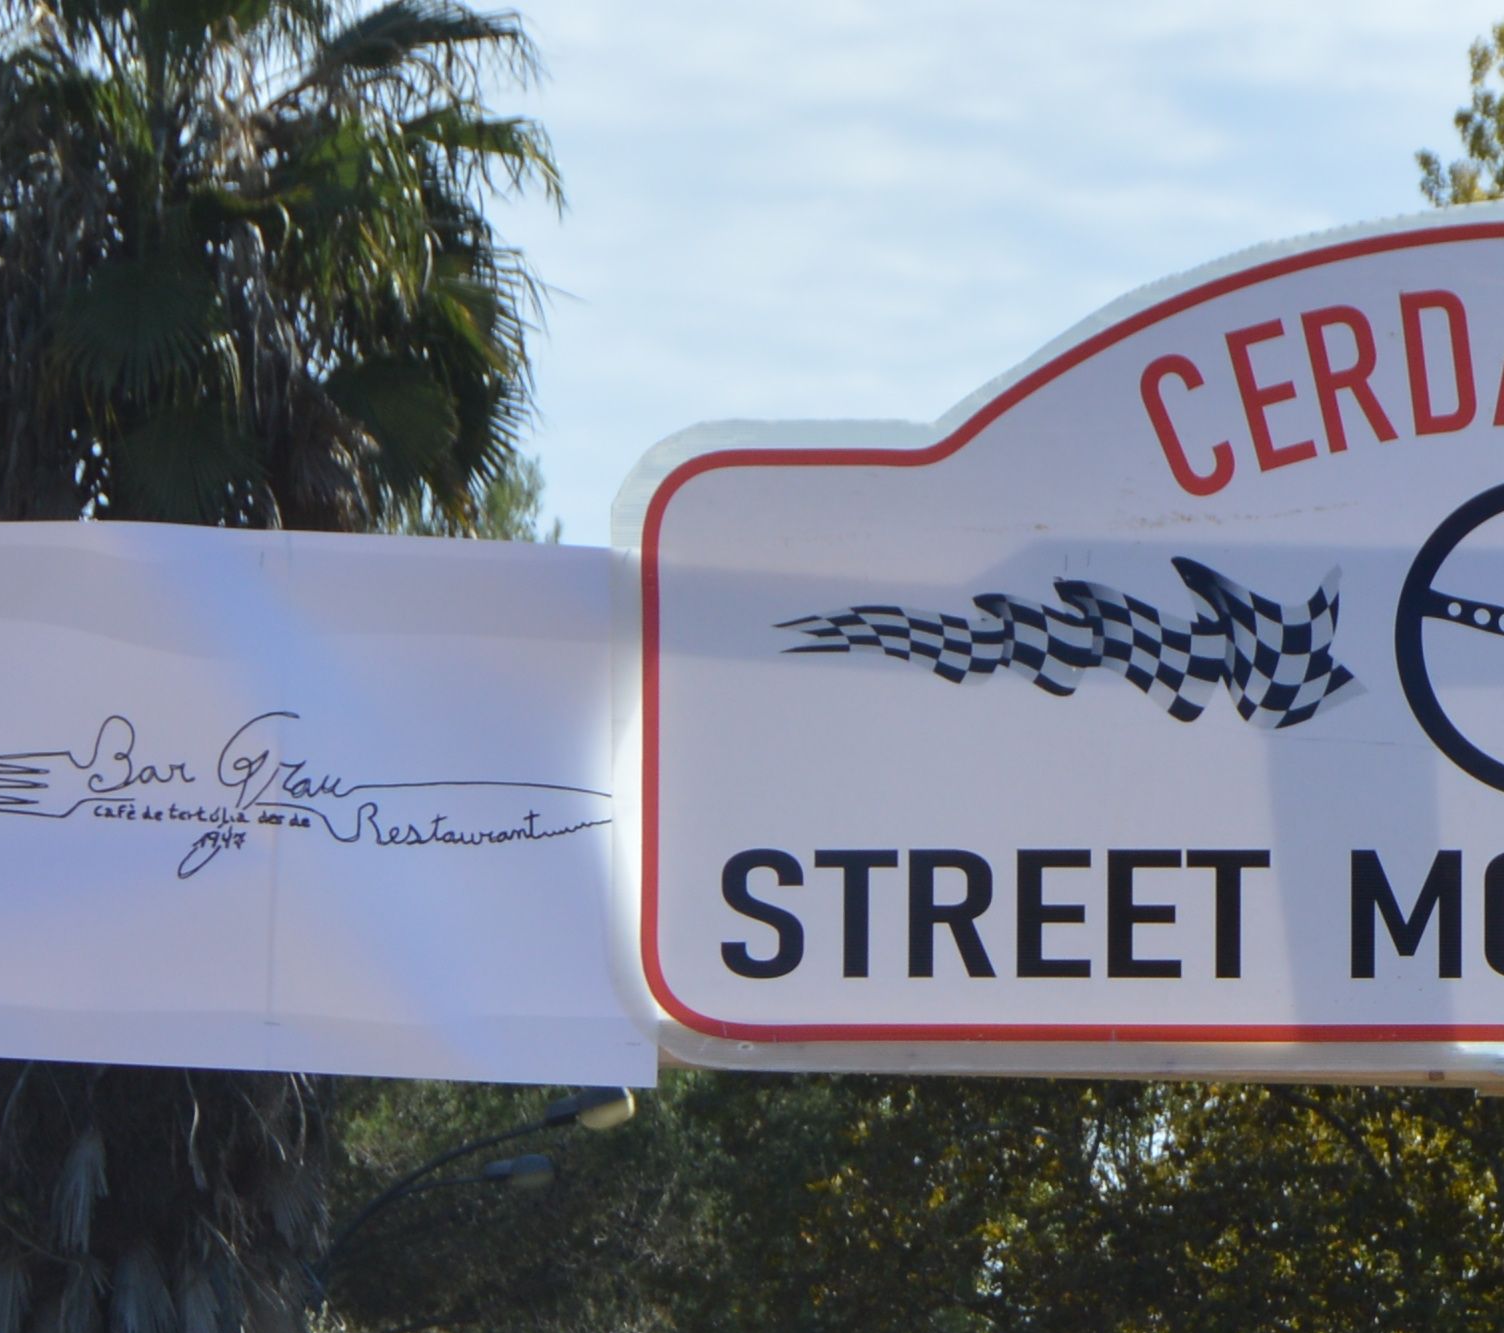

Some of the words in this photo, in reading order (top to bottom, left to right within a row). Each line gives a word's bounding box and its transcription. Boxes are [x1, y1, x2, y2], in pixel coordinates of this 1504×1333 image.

[87, 715, 195, 794] Bar
[142, 803, 163, 821] de
[289, 812, 312, 828] de
[352, 801, 553, 847] Restaurant
[719, 846, 1272, 980] STREET
